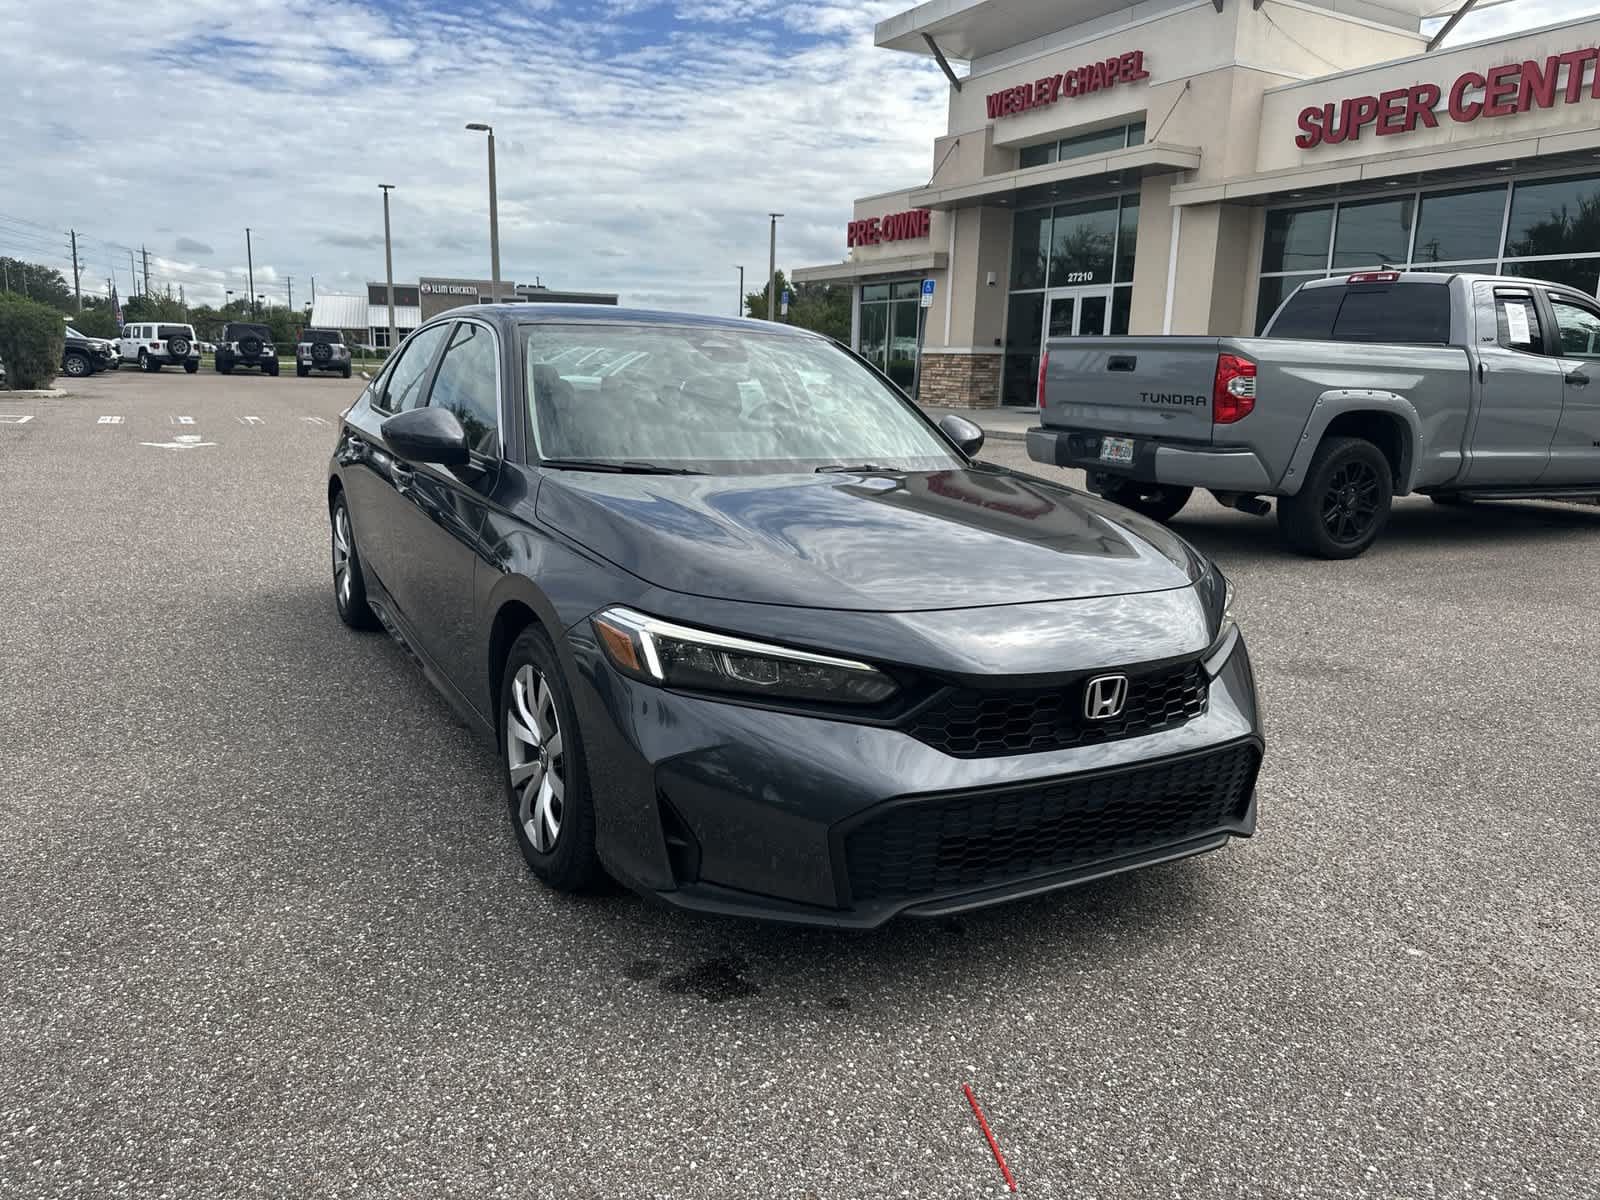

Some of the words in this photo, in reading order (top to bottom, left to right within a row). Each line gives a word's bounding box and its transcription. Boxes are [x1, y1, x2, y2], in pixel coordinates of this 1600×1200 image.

[986, 74, 1063, 119] WESLEY
[1062, 50, 1150, 98] CHAPEL
[1295, 83, 1441, 149] SUPER
[1067, 271, 1093, 282] 27210
[1140, 392, 1207, 407] TUNDRA
